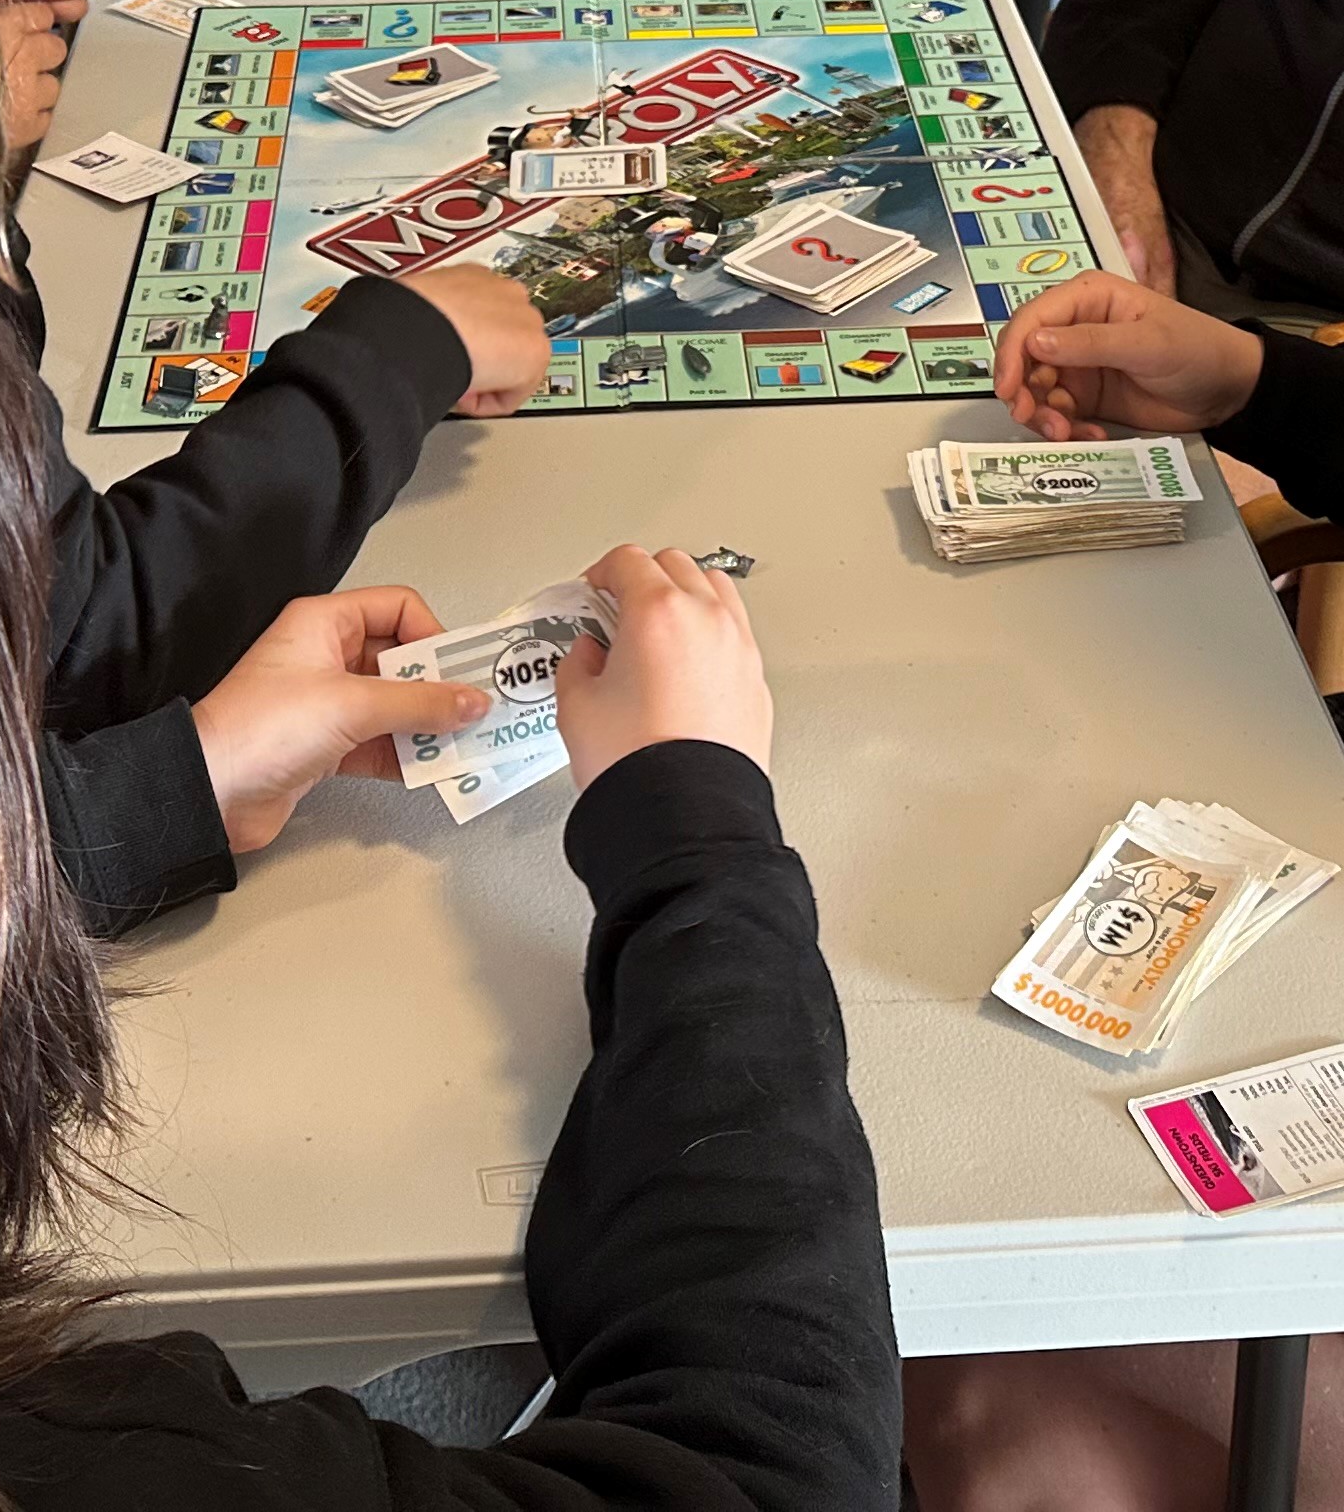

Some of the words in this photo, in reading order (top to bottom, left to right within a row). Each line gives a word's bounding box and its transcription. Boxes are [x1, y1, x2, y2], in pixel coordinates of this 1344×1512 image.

[120, 371, 135, 390] JUST
[1001, 451, 1105, 465] MONOPOLY
[1147, 446, 1186, 498] $200,000
[1035, 478, 1097, 490] $200k
[492, 713, 557, 747] OPOLY
[1096, 905, 1146, 950] $1M
[1142, 901, 1210, 988] MONOPOLY
[1013, 972, 1133, 1041] $1,000,000
[1168, 1127, 1217, 1190] QUEENSTOWN
[1188, 1133, 1214, 1163] FIELDS
[1207, 1162, 1225, 1178] SKI
